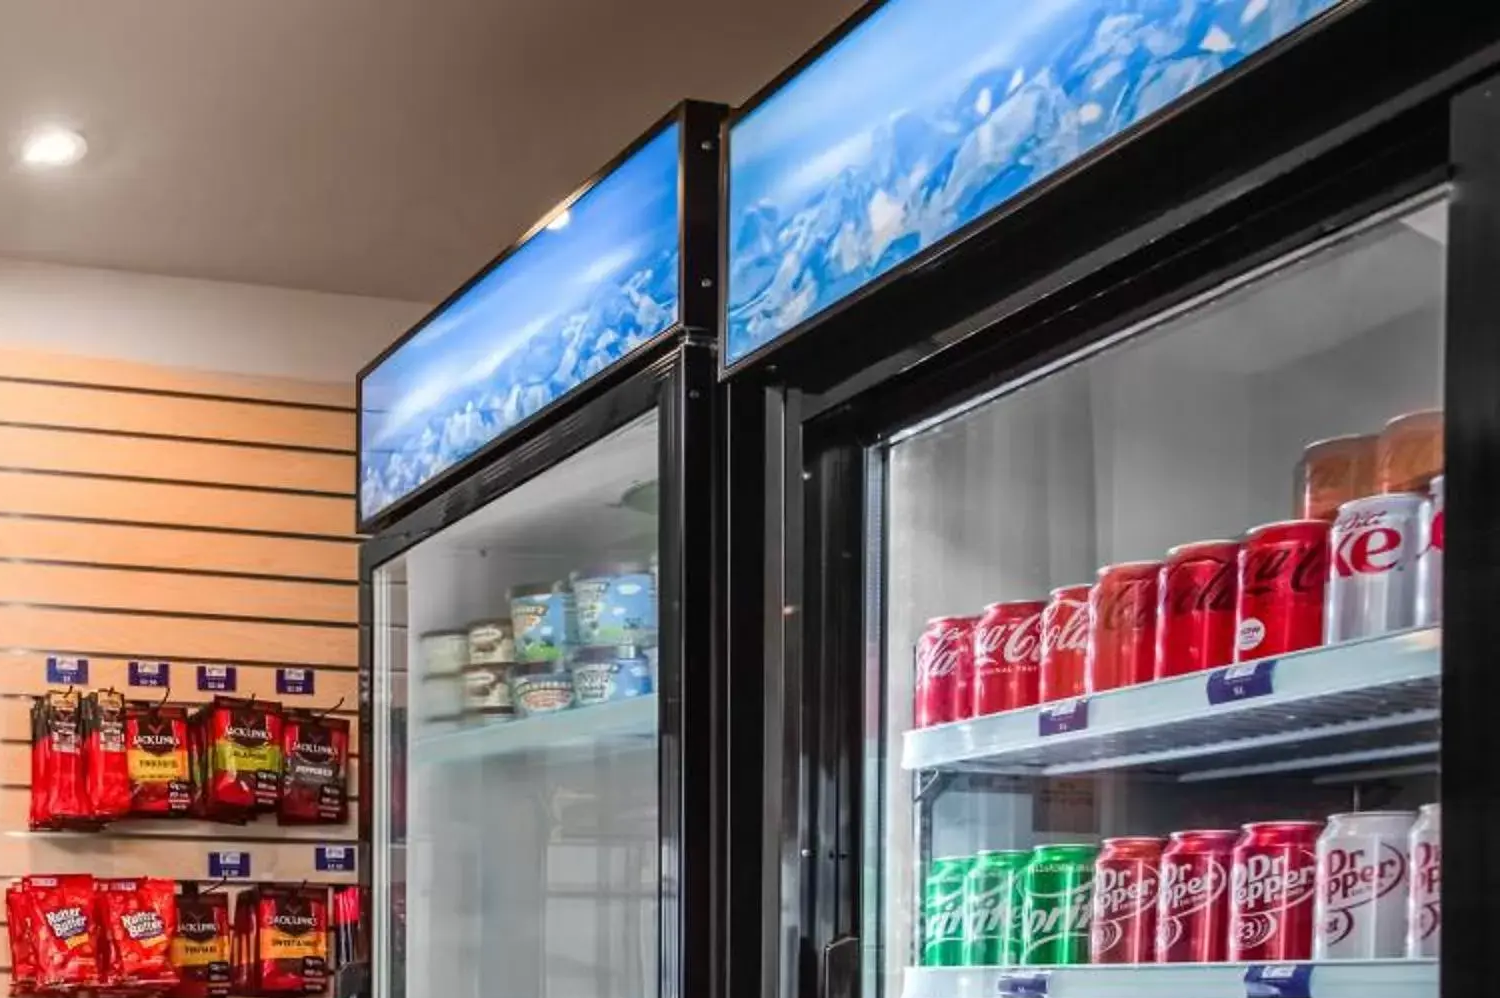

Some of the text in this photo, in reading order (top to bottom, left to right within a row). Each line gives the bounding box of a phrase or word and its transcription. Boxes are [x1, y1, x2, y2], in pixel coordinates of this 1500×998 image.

[1336, 527, 1402, 577] ke
[1101, 867, 1132, 892] Dr
[1250, 853, 1286, 882] Dr
[1328, 849, 1365, 876] Dr
[1100, 879, 1156, 913] pper
[1164, 873, 1220, 909] pper
[1327, 860, 1397, 904] pper
